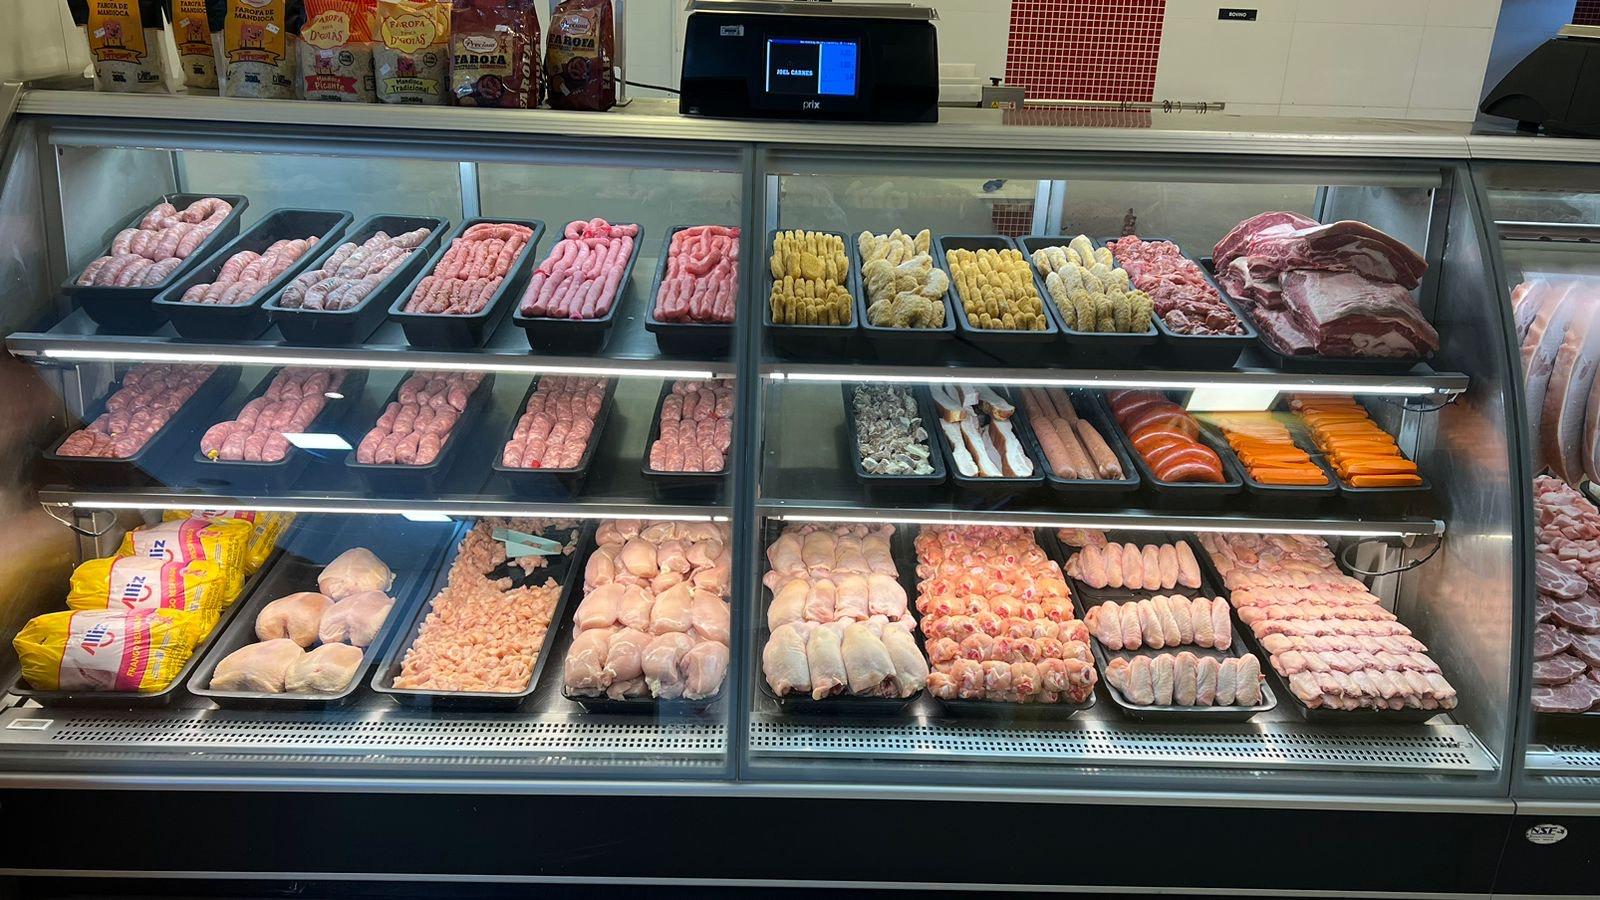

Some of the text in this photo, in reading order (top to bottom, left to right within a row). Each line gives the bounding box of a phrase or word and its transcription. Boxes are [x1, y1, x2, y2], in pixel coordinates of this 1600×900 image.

[235, 7, 264, 15] FAROFA
[234, 13, 274, 22] MANDIOCA
[454, 54, 507, 65] FAROFA
[803, 100, 820, 110] prix
[127, 645, 141, 677] FRANGO
